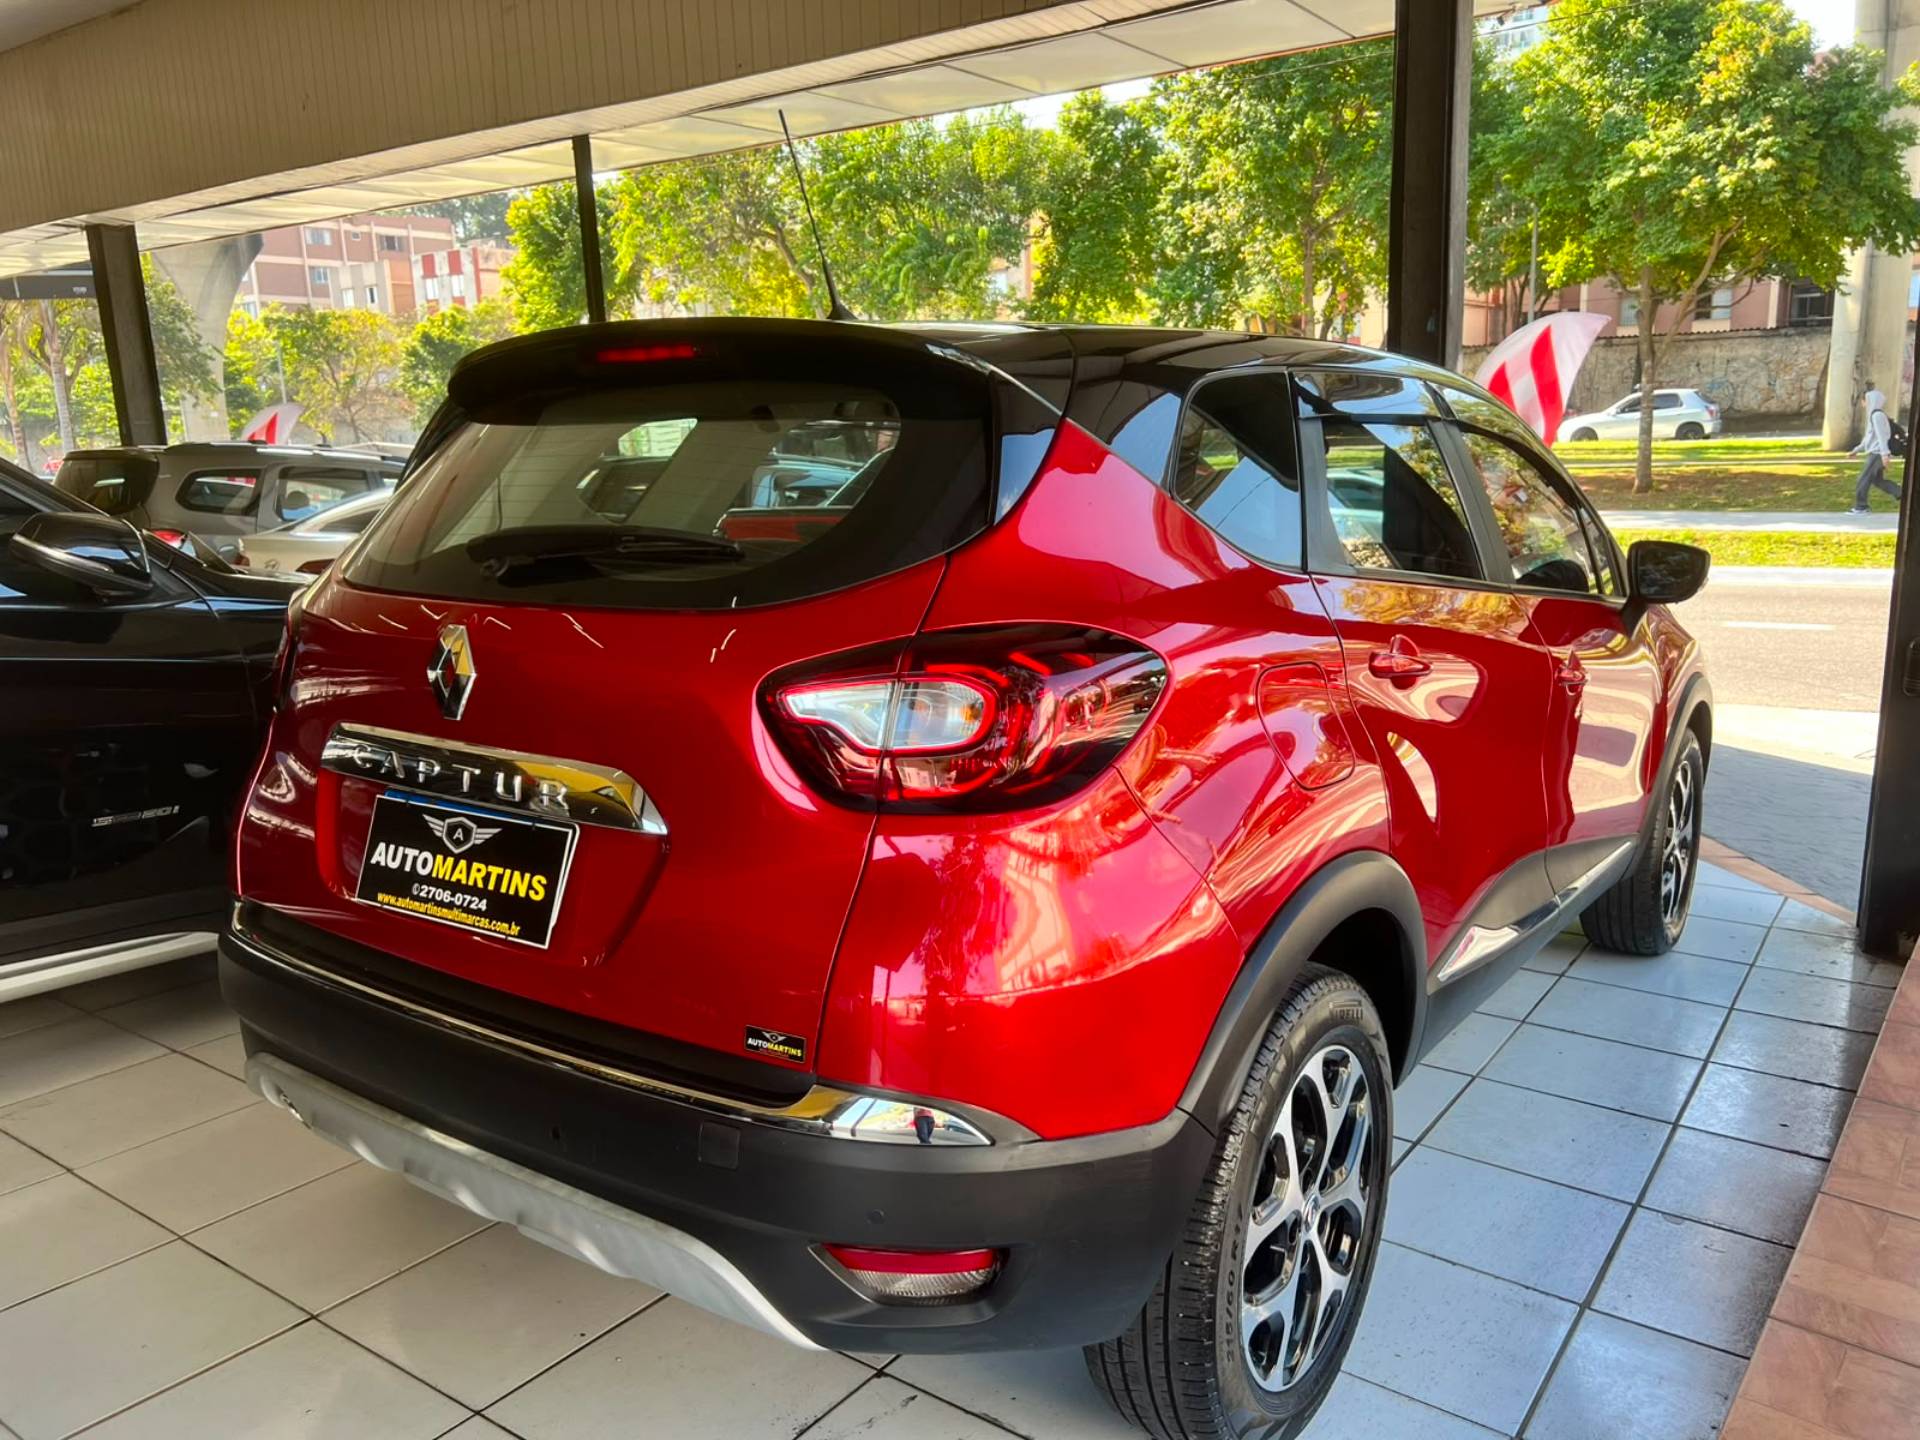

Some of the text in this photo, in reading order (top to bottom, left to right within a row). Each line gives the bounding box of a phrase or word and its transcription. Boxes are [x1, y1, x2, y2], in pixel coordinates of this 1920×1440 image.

[352, 744, 570, 815] CAPTUR
[370, 841, 547, 901] AUTOMARTINS
[377, 891, 520, 936] www.automartinsmultimarcas.com.br
[419, 884, 488, 911] 2706-0724
[747, 1037, 802, 1057] AUTOMARTINS
